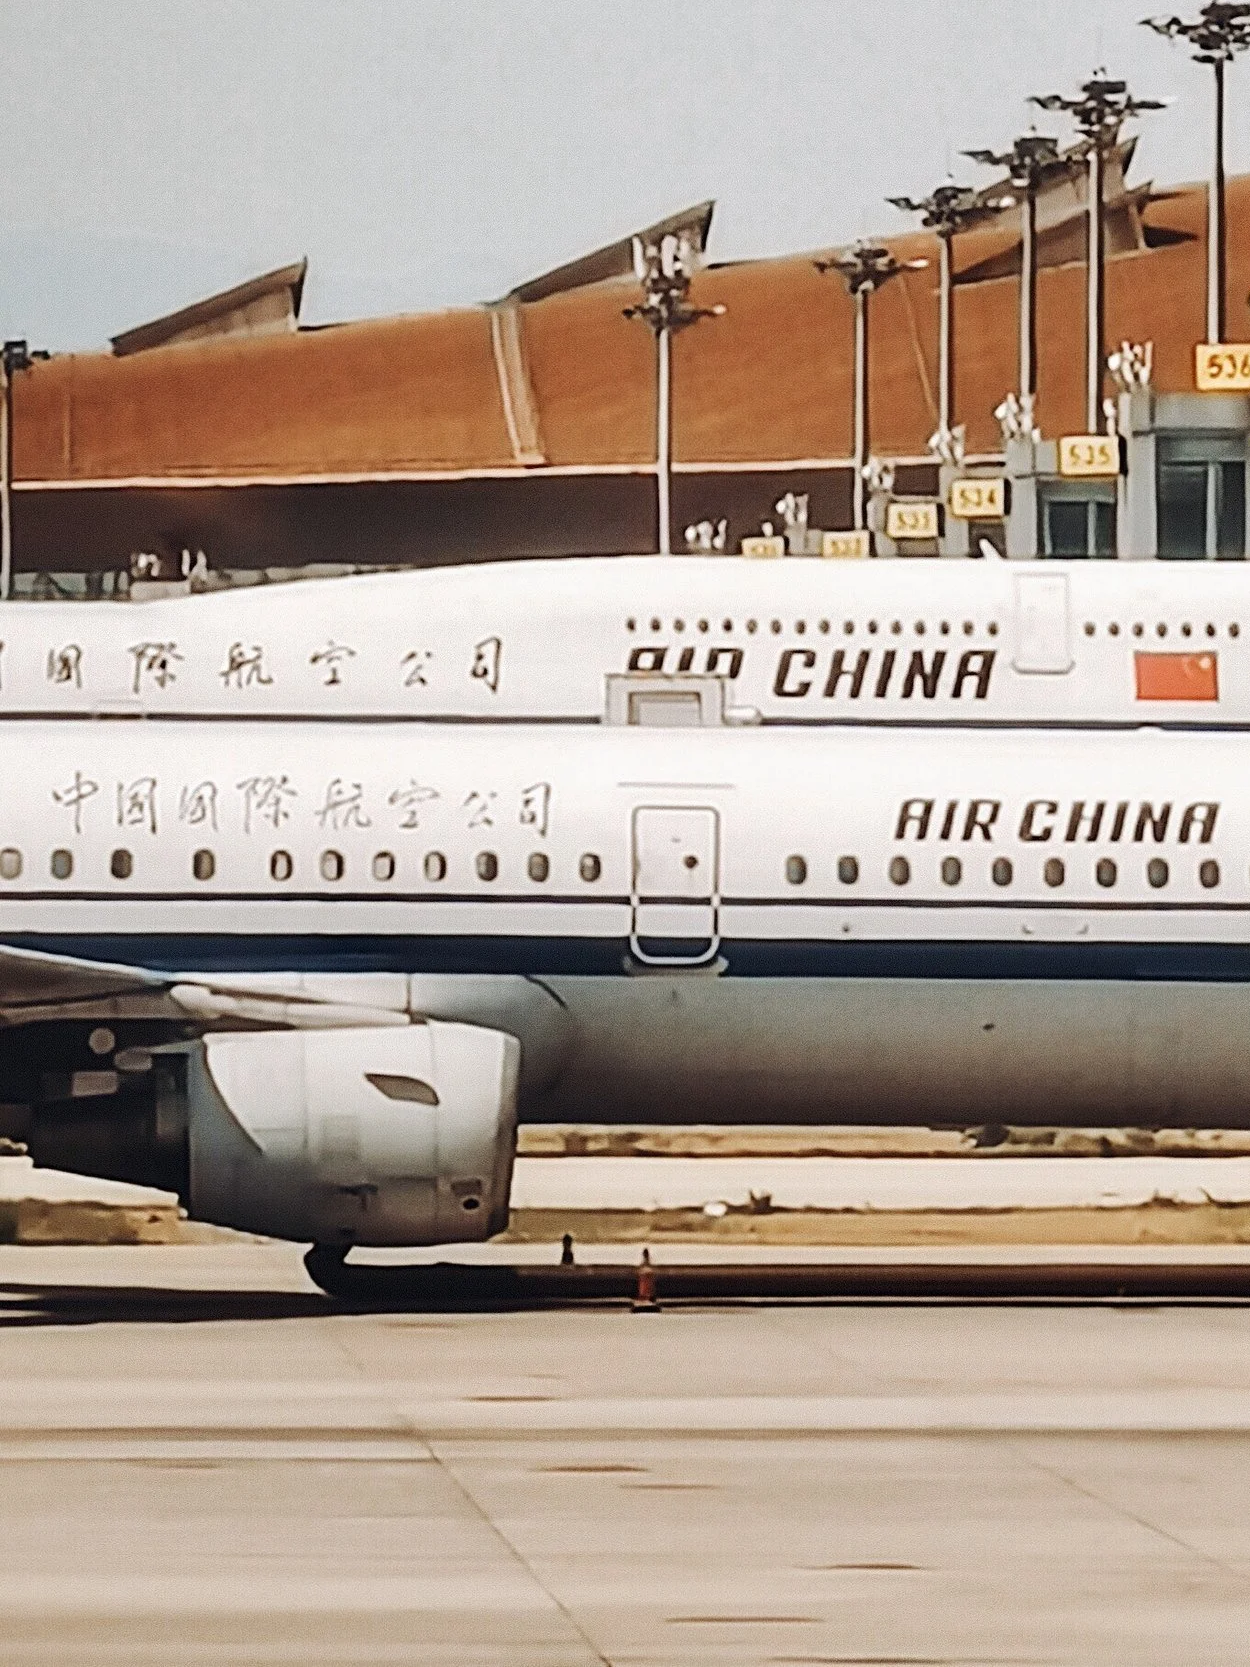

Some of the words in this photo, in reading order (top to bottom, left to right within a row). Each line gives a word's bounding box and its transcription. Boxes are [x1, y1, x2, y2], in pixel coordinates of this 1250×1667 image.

[772, 648, 998, 700] CHINA
[894, 798, 1002, 843] AIR
[1017, 799, 1220, 845] CHINA
